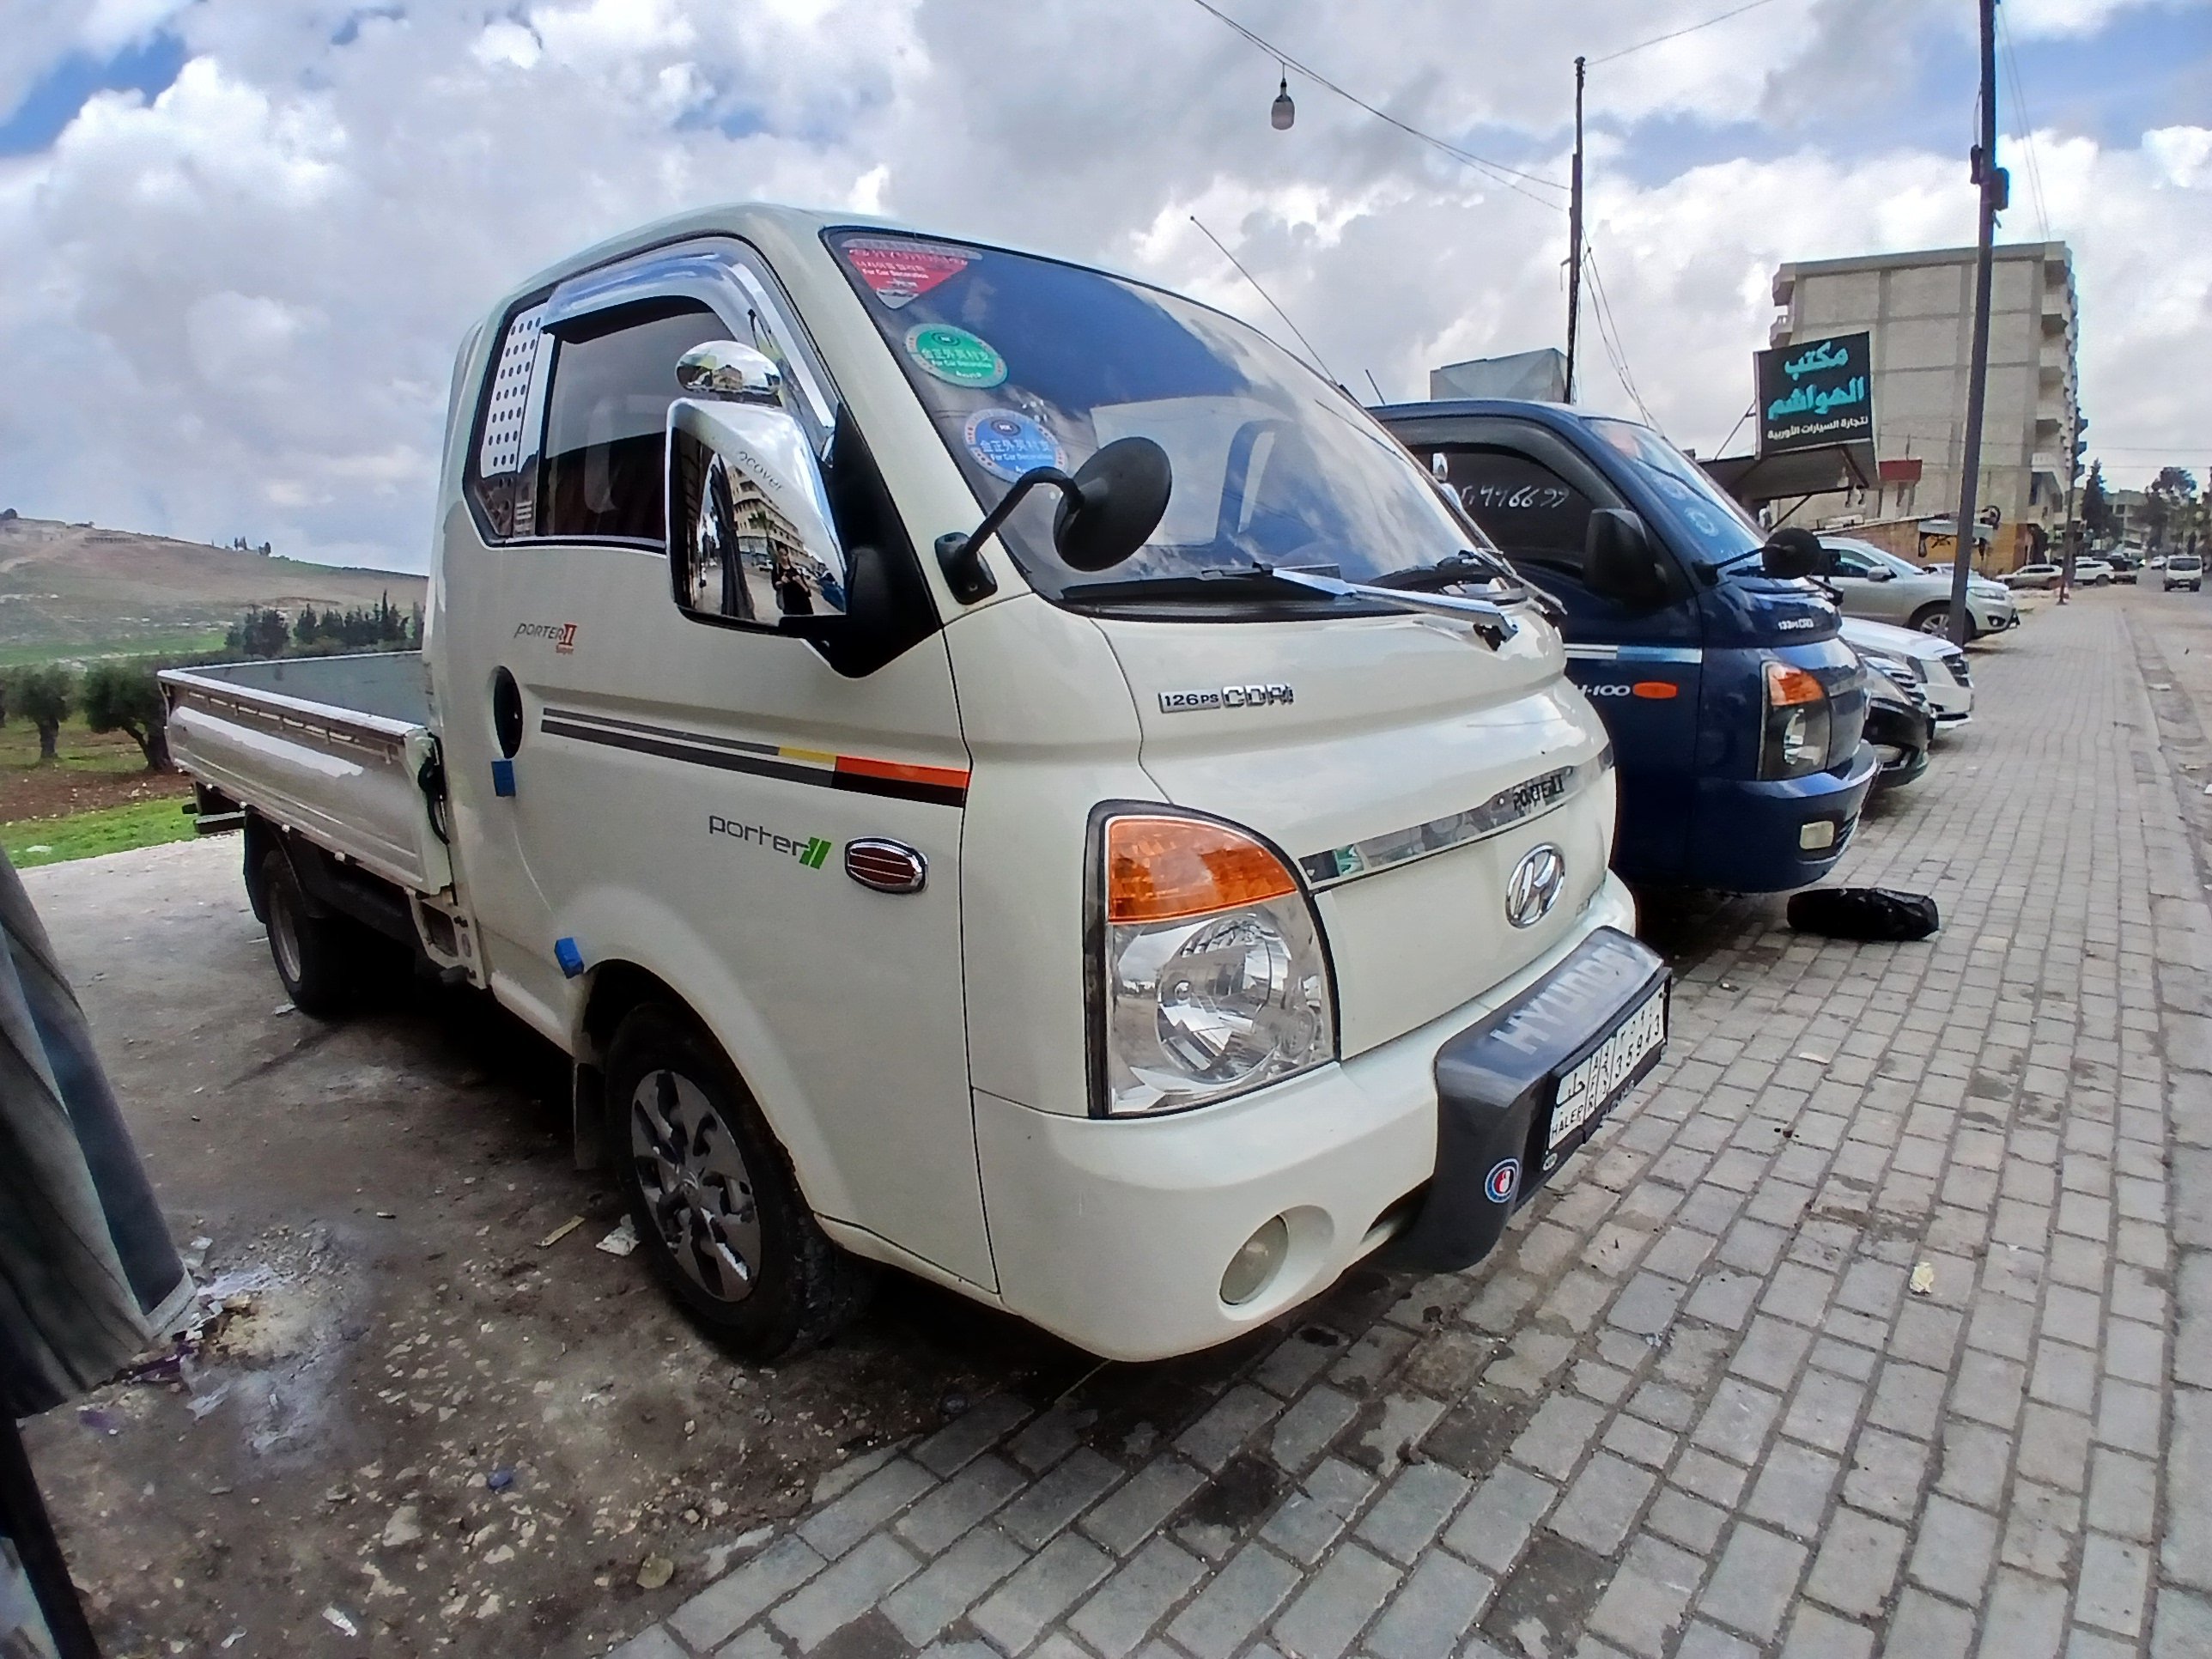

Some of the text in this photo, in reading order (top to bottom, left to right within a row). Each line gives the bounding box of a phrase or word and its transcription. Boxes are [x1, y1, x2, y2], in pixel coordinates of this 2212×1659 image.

[1784, 341, 1849, 380] مكتب
[1801, 420, 1839, 434] السيارات
[1614, 1013, 1661, 1080] 35943
[1550, 1103, 1585, 1141] HALEP
